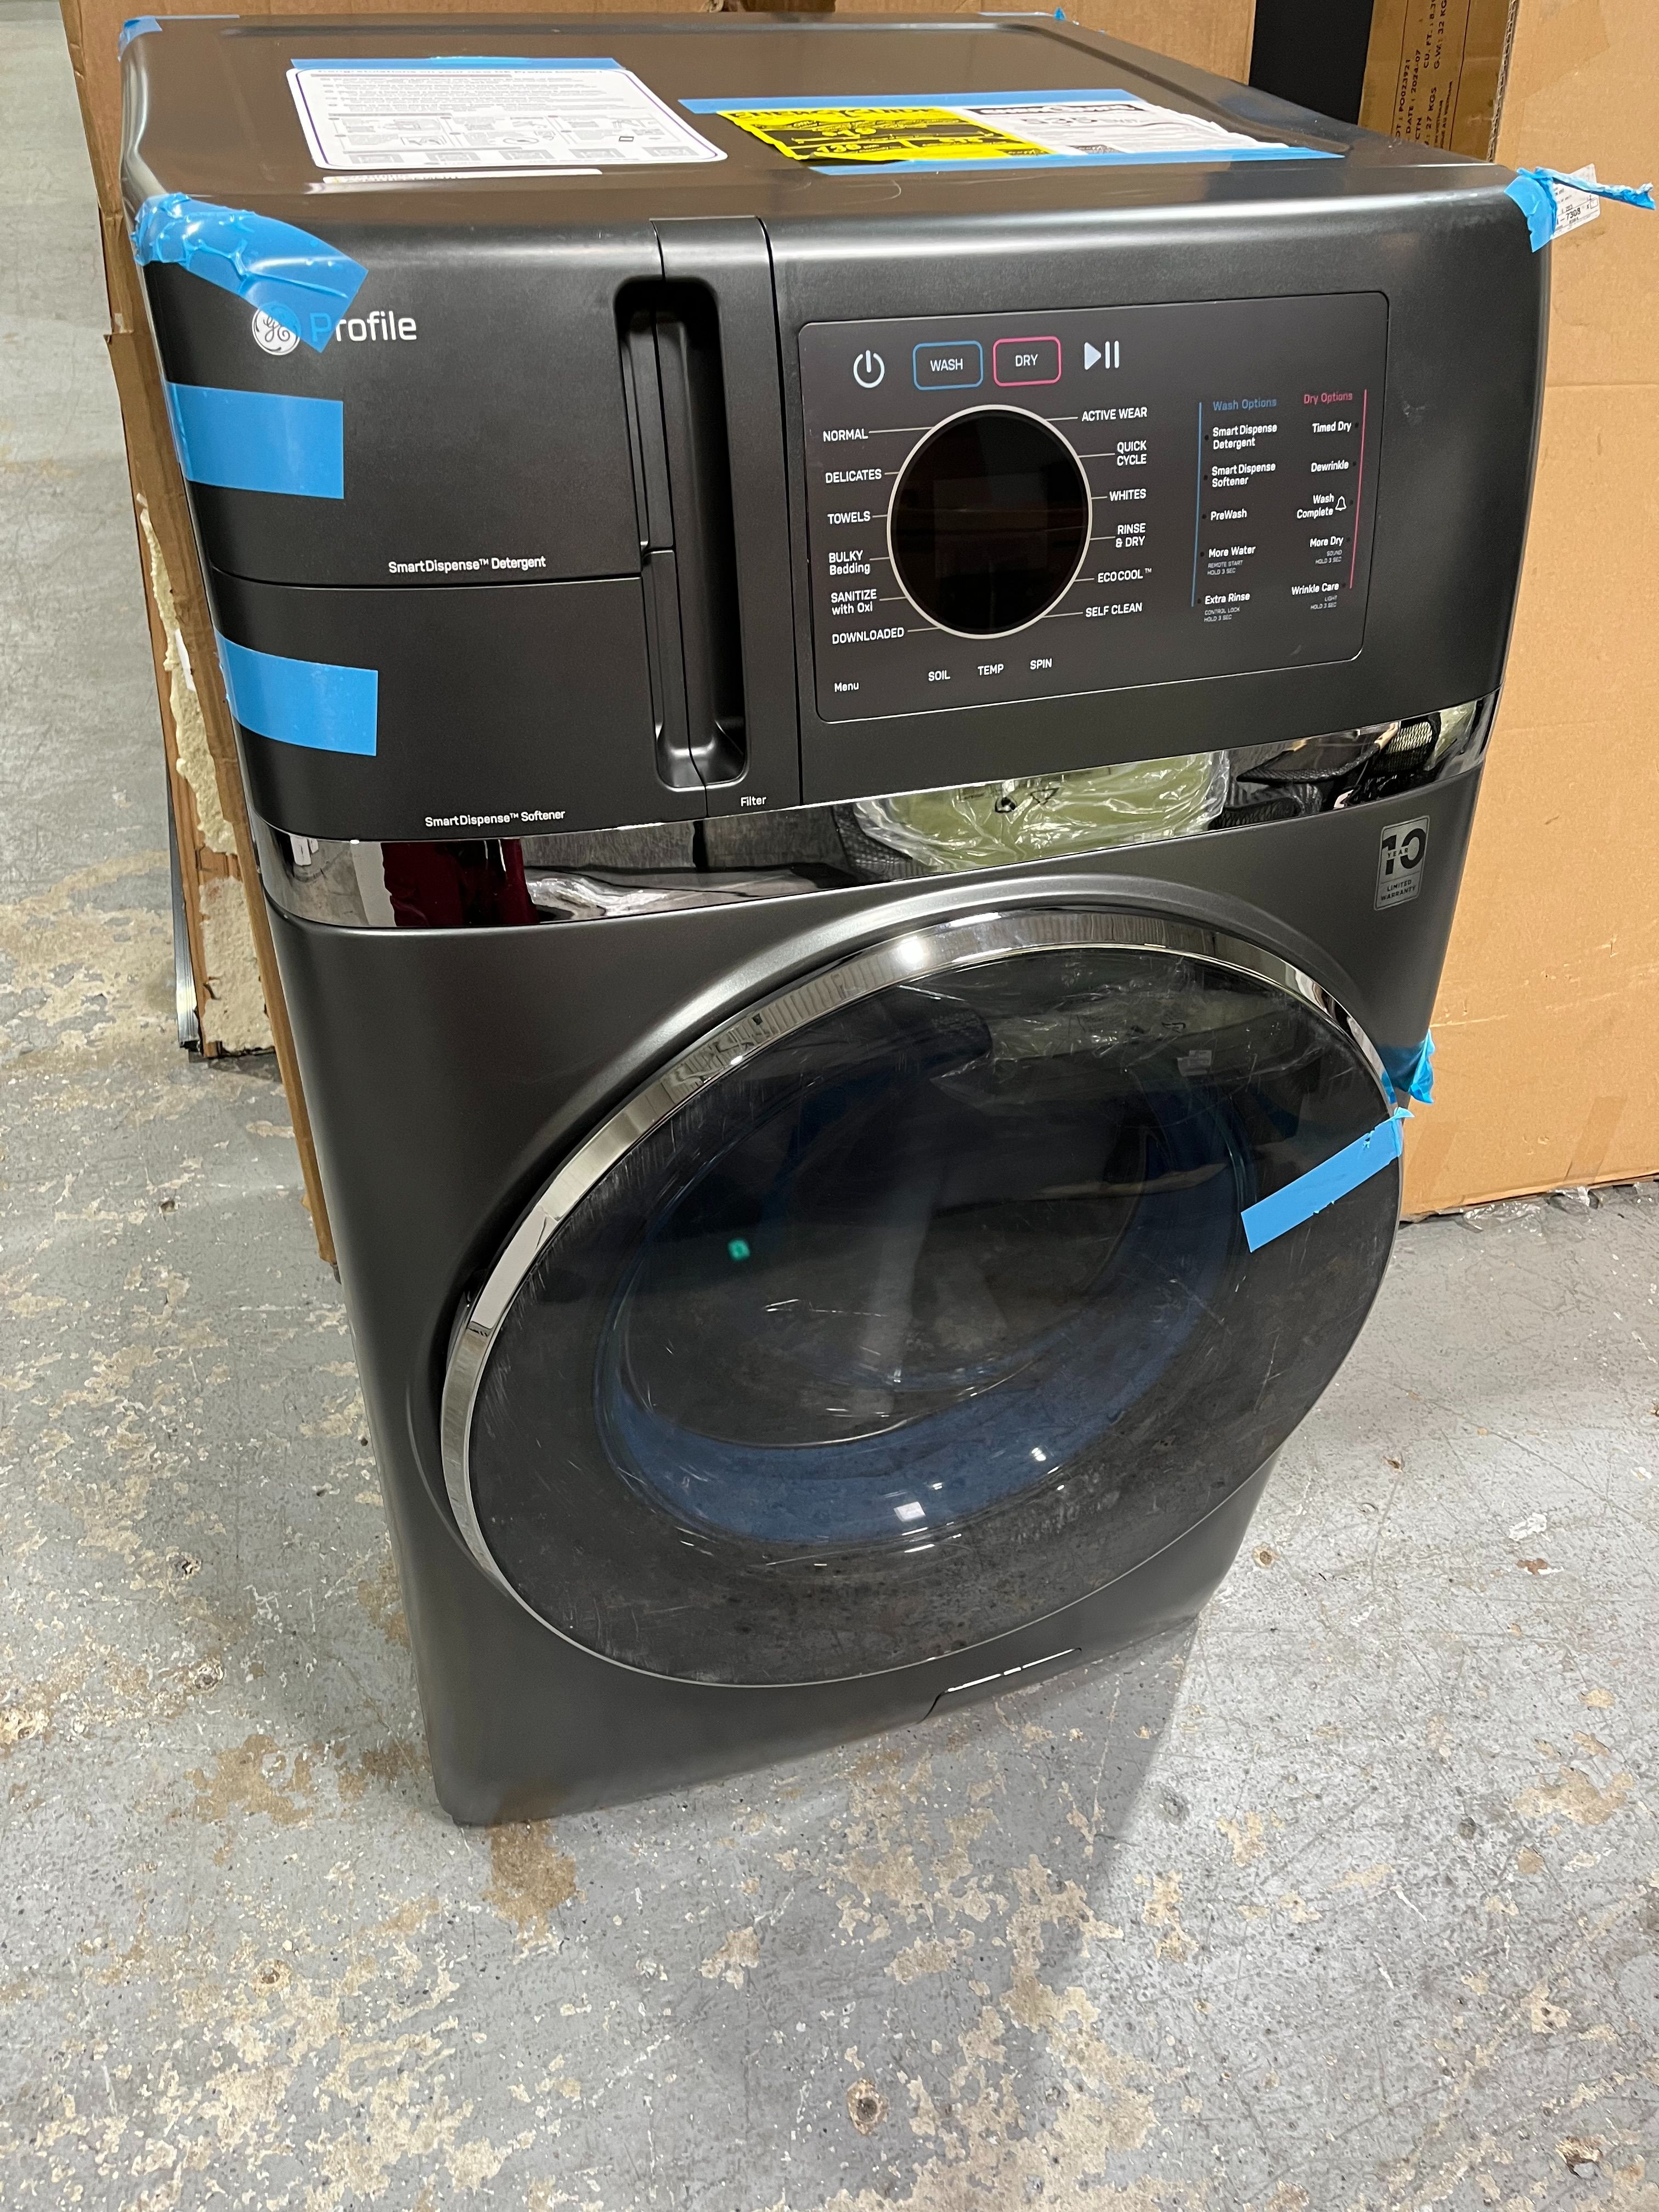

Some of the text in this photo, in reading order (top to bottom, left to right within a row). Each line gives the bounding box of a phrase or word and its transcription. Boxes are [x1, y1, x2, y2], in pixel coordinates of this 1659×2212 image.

[1438, 21, 1444, 34] 32
[1428, 87, 1437, 111] KGS
[1406, 106, 1414, 134] DATE
[930, 358, 963, 371] WASH
[1015, 354, 1038, 366] DRY
[1213, 399, 1277, 410] Wash Options
[1304, 392, 1353, 405] Dry Options
[1082, 407, 1147, 421] ACTIVE WEAR
[1312, 421, 1351, 433] Timed Dry
[823, 428, 868, 442] NORMAL
[1118, 440, 1147, 452] QUICK
[1214, 437, 1255, 449] Detergent
[1117, 453, 1147, 466] CYCLE
[1311, 460, 1348, 472] Dewrinkle
[826, 469, 882, 483] DELICATES
[1212, 477, 1249, 487] Softener
[1109, 489, 1146, 501] WHITES
[1313, 493, 1334, 504] Wash
[827, 511, 870, 524] TOWELS
[1211, 509, 1247, 520] PreWash
[1297, 507, 1333, 519] Complete
[1118, 523, 1146, 534] RINSE
[1116, 536, 1145, 548] & DRY
[1310, 536, 1344, 547] More Dry
[829, 550, 863, 563] BULKY
[1209, 546, 1256, 557] More Water
[492, 556, 546, 571] Detergent
[830, 562, 870, 575] Bedding
[1292, 583, 1339, 595] Wrinkle Care
[831, 589, 877, 603] SANITIZE
[1205, 592, 1250, 605] Extra Rinse
[832, 601, 872, 615] with Oxi
[1086, 602, 1142, 617] SELF CLEAN
[832, 628, 904, 644] DOWNLOADED
[978, 664, 1003, 675] TEMP
[1030, 658, 1052, 669] SPIN
[928, 670, 950, 681] SOIL
[834, 682, 859, 692] Menu
[741, 797, 766, 806] Filter
[521, 810, 565, 821] Softener
[1382, 828, 1426, 875] 10
[1387, 848, 1408, 859] YEAR
[1387, 879, 1412, 892] LIMITED
[1381, 885, 1416, 901] WARRANTY
